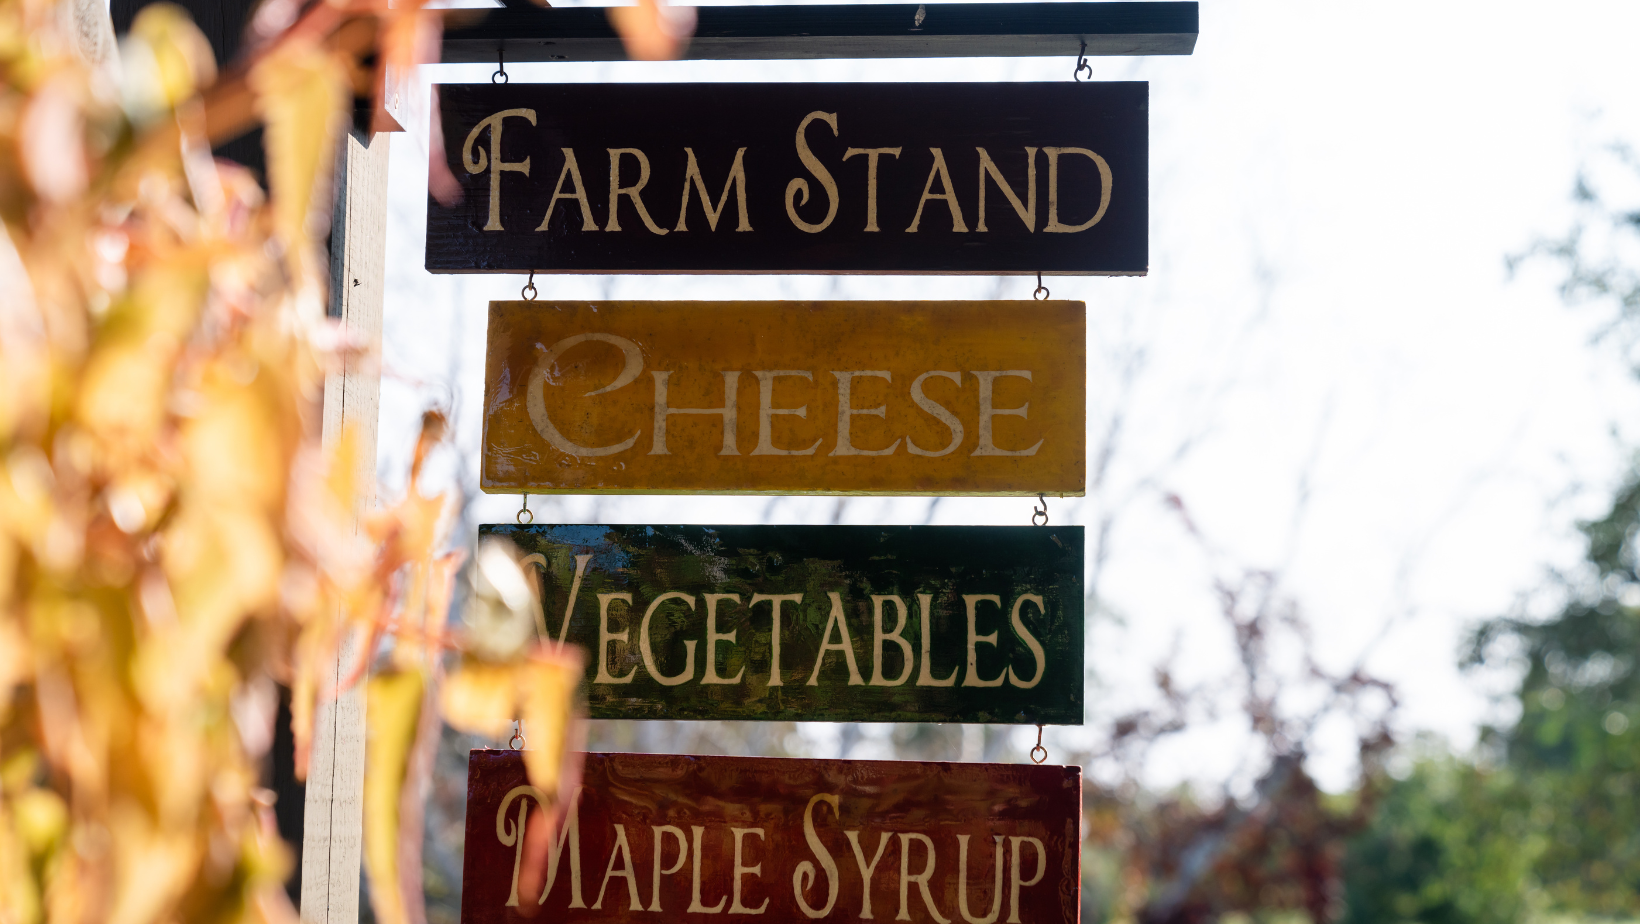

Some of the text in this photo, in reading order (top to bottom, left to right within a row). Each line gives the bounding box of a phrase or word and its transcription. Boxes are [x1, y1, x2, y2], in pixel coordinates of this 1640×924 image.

[462, 107, 1114, 236] FARM STAND
[525, 331, 1045, 459] CHEESE
[495, 784, 1047, 924] MAPLE SYRUP
